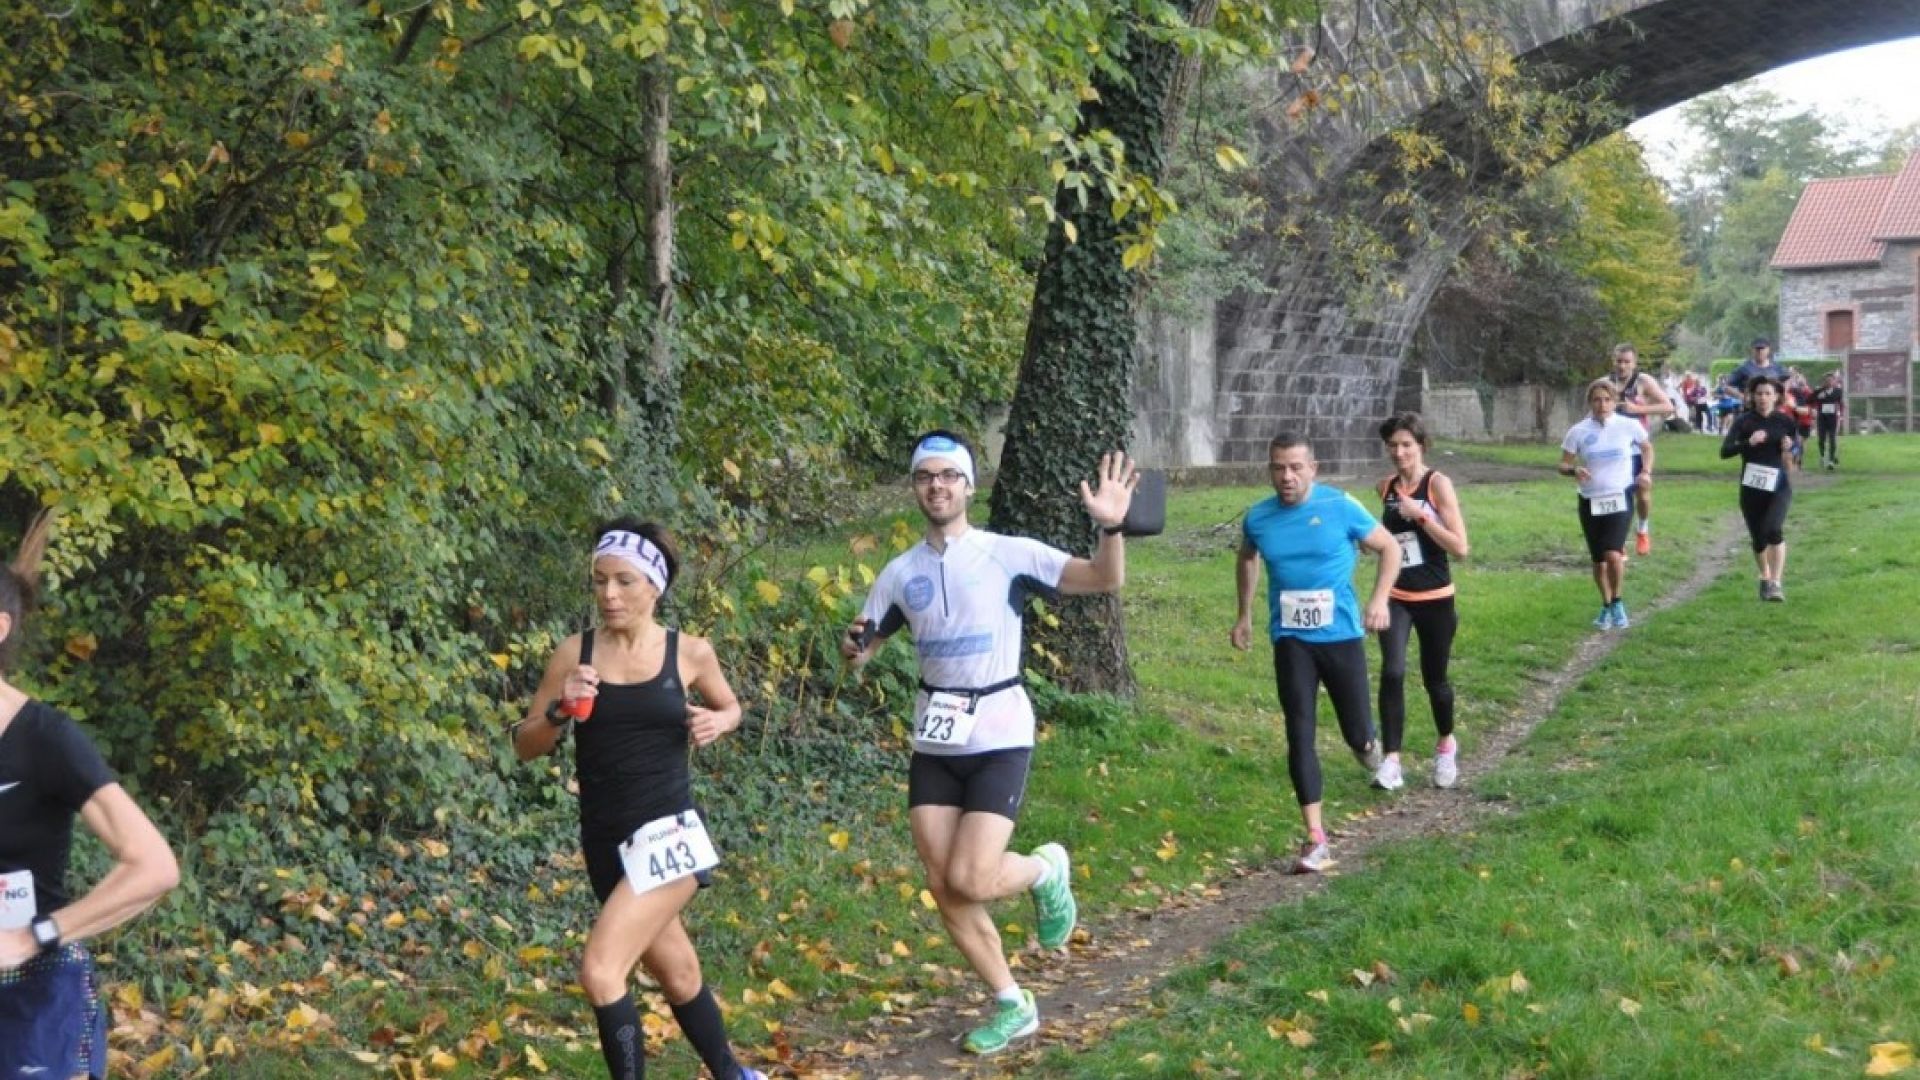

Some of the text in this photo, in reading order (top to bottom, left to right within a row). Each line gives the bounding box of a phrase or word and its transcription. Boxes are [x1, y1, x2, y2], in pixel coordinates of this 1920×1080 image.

[1292, 607, 1321, 627] 430
[919, 714, 955, 741] 423
[649, 841, 696, 880] 443
